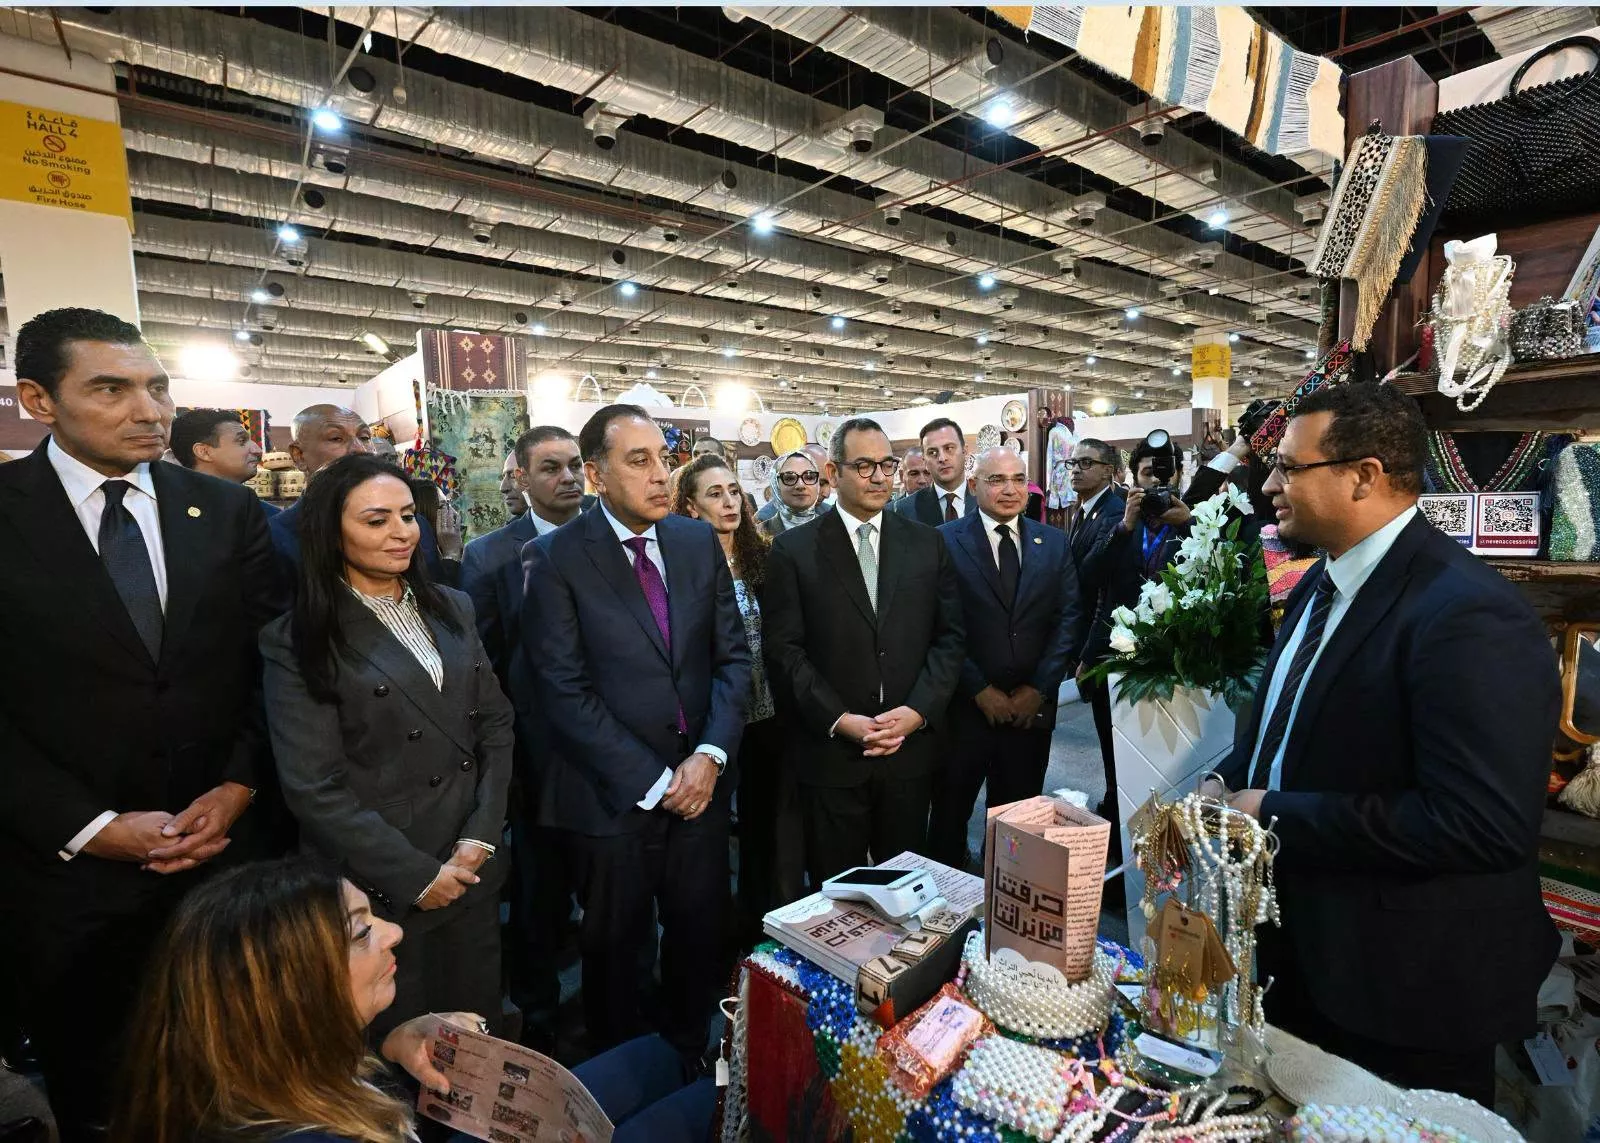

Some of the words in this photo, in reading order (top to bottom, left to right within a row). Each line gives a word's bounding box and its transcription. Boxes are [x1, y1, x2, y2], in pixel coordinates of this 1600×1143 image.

[26, 110, 33, 119] ٤
[38, 112, 78, 128] قاعة
[27, 120, 66, 136] HALL
[69, 128, 78, 138] 4
[24, 148, 56, 160] التدخين
[58, 155, 87, 166] ممنوع
[23, 155, 39, 166] No
[41, 157, 91, 175] Smoking
[28, 186, 61, 196] الحريق
[62, 190, 92, 201] صندوق
[36, 194, 57, 204] Fire
[59, 198, 87, 209] Hose
[995, 866, 1064, 917] حرفتنا
